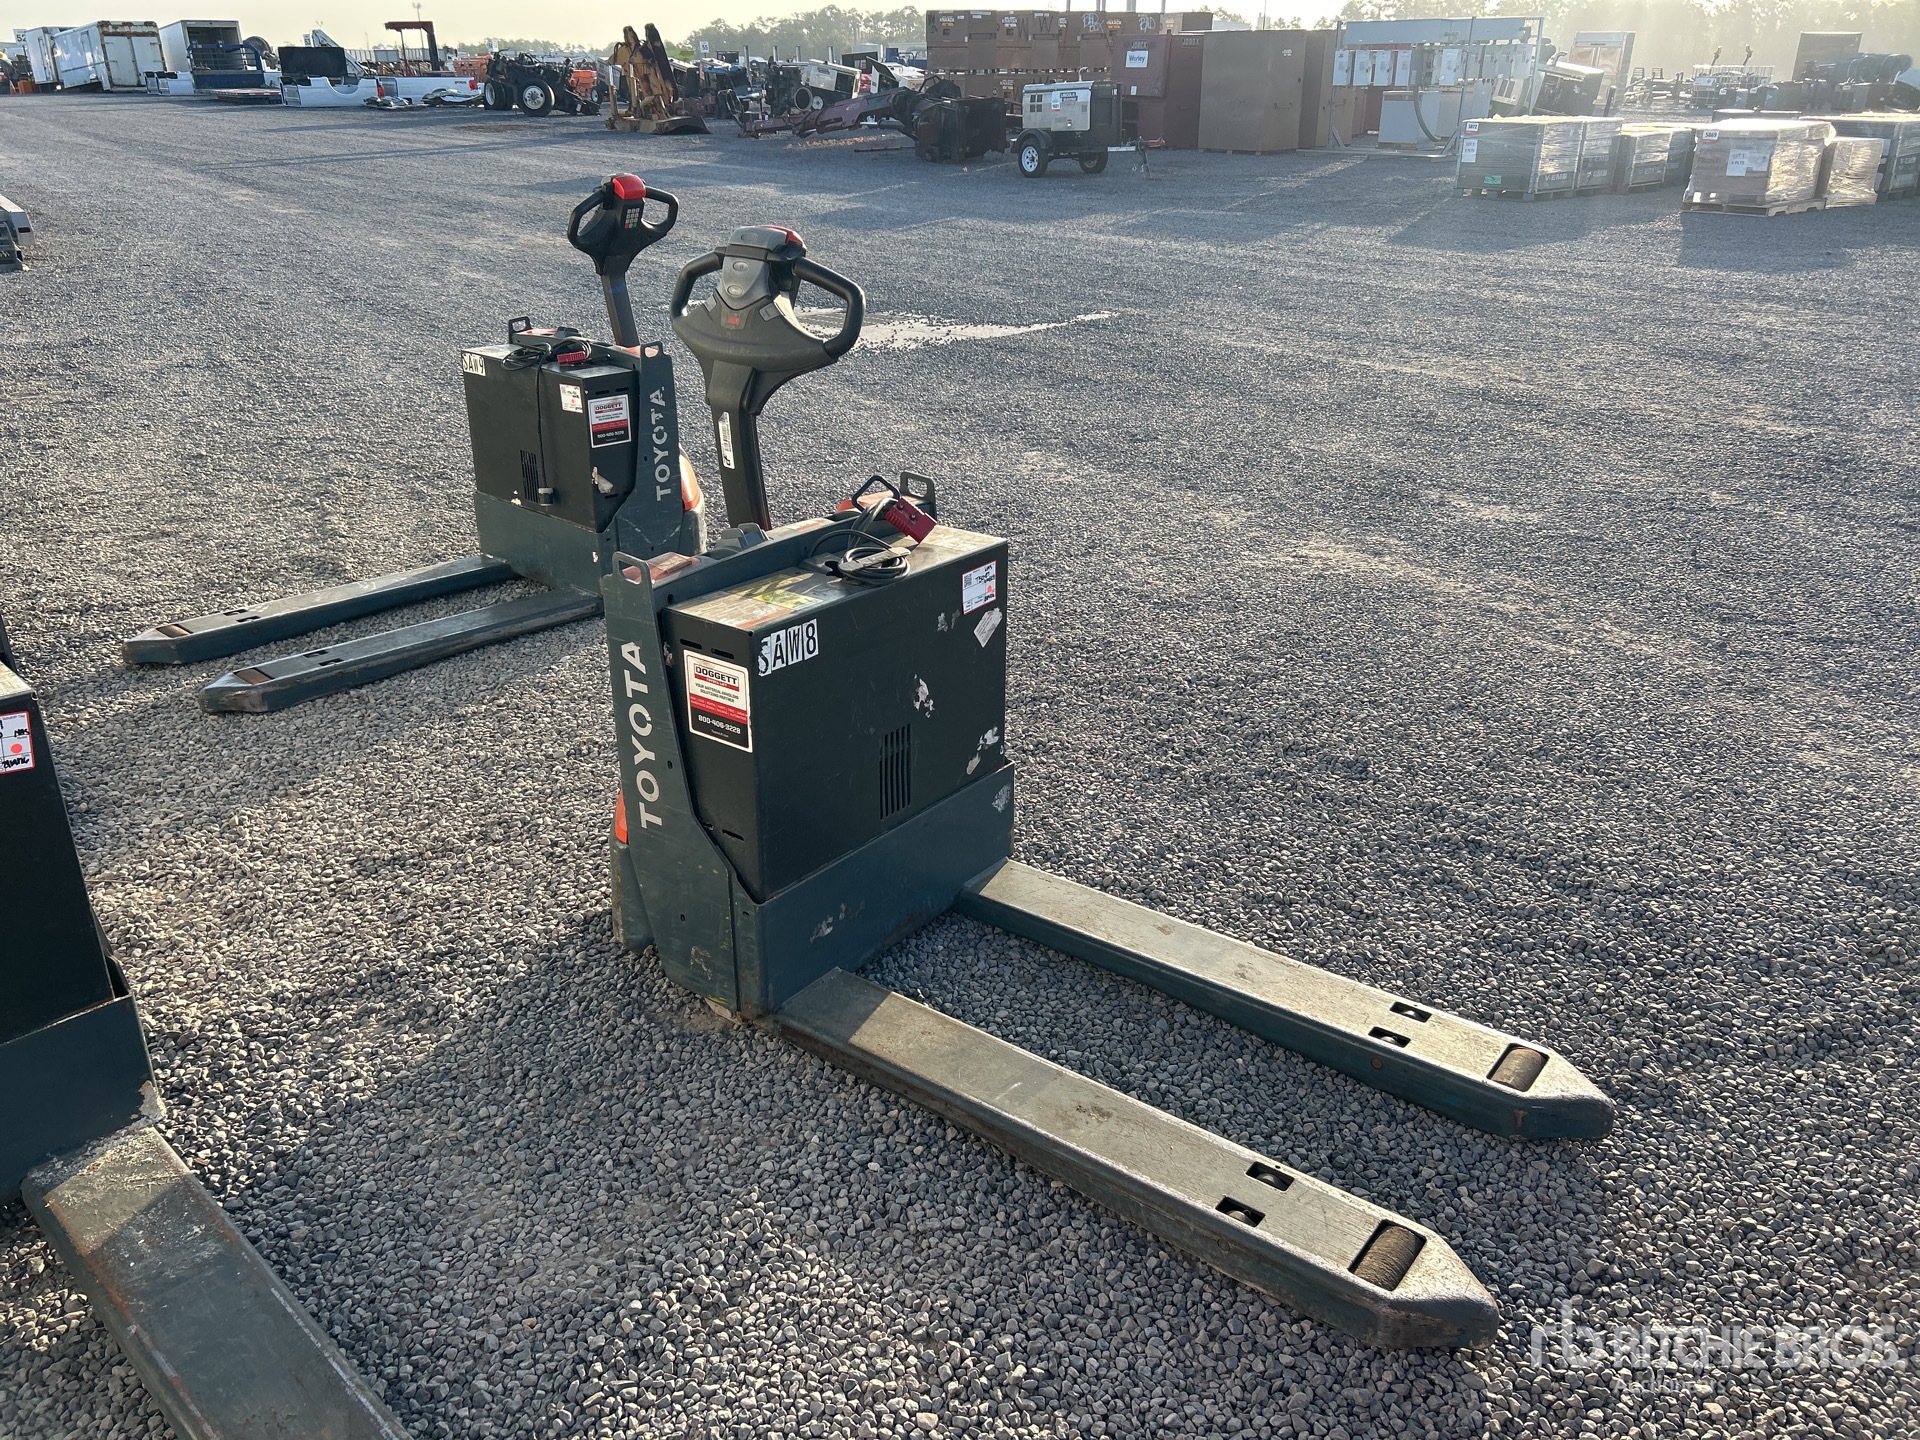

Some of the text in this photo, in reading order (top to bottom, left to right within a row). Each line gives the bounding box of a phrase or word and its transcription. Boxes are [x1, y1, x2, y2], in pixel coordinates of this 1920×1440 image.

[650, 386, 671, 501] TOYOTA
[695, 666, 738, 685] DOGGETT
[760, 622, 817, 674] SAW8
[621, 641, 663, 829] TOYOTA
